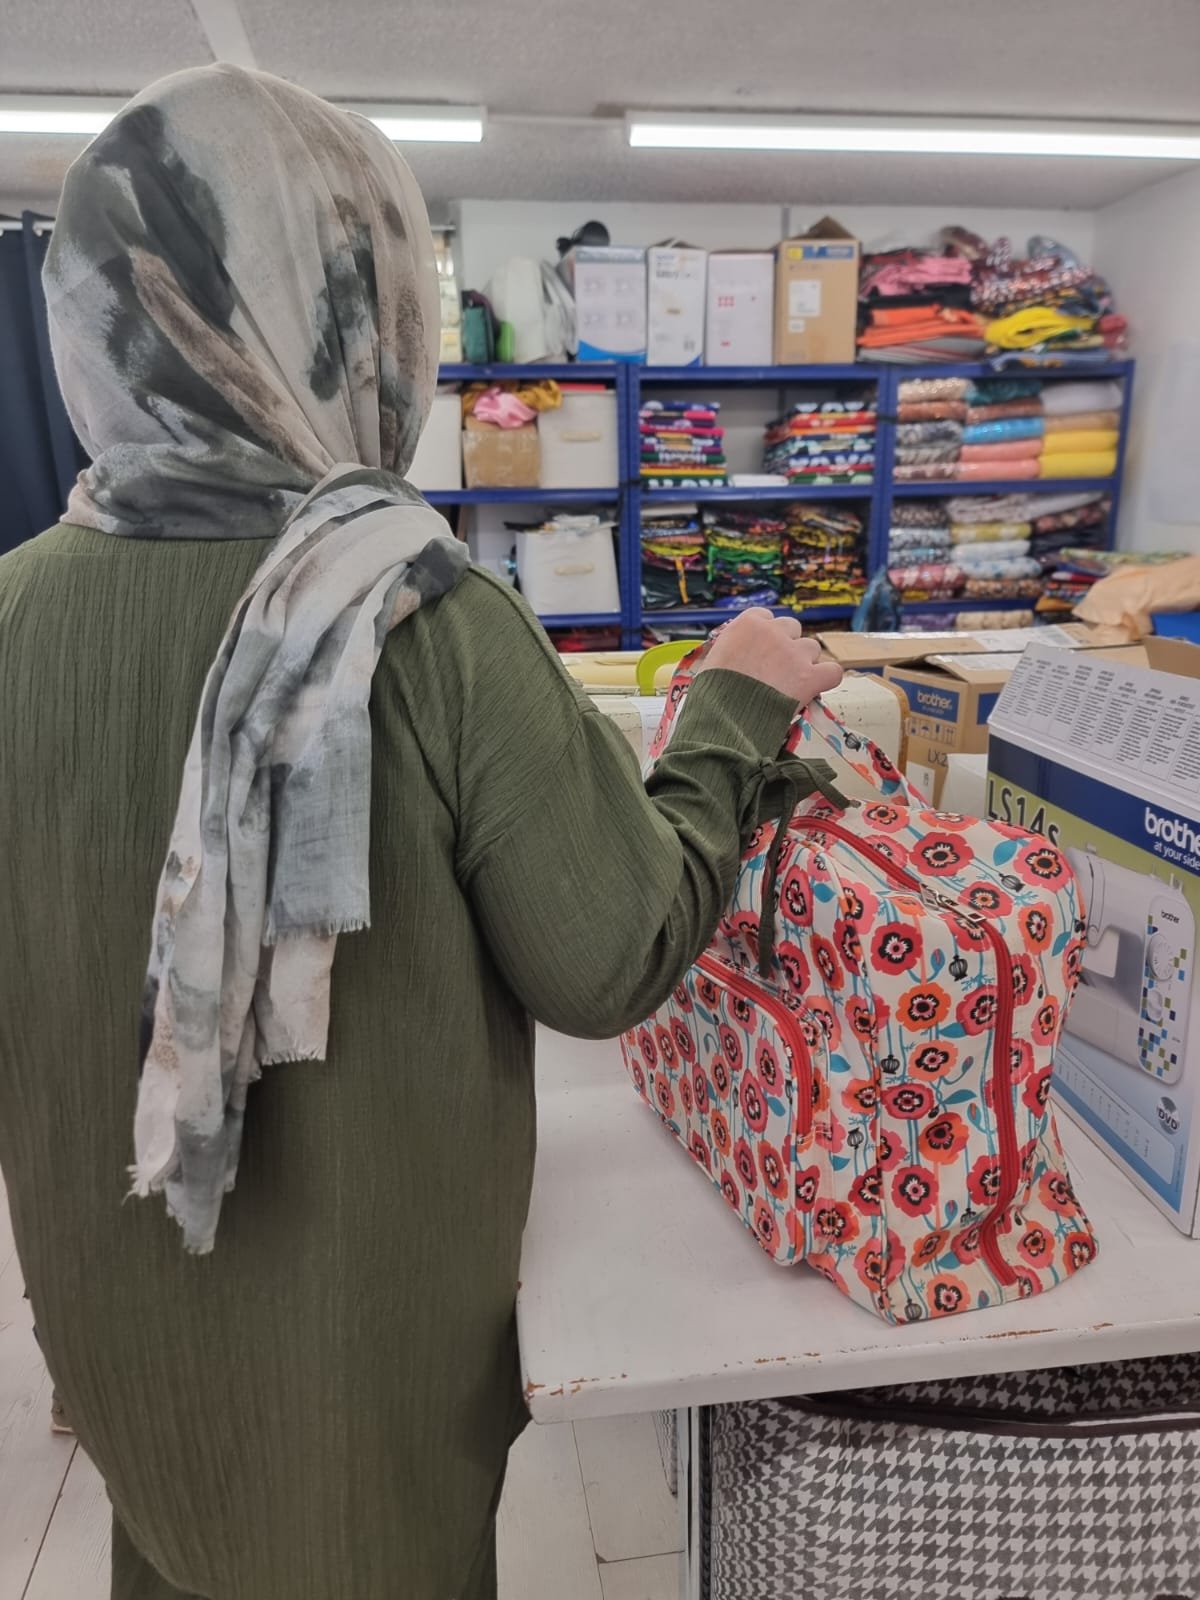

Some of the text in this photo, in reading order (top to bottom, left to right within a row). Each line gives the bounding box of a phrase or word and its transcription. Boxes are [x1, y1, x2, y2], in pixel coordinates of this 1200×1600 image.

[917, 690, 952, 709] brother
[1154, 842, 1162, 852] at
[1163, 846, 1182, 861] your
[1158, 1108, 1178, 1130] DVD
